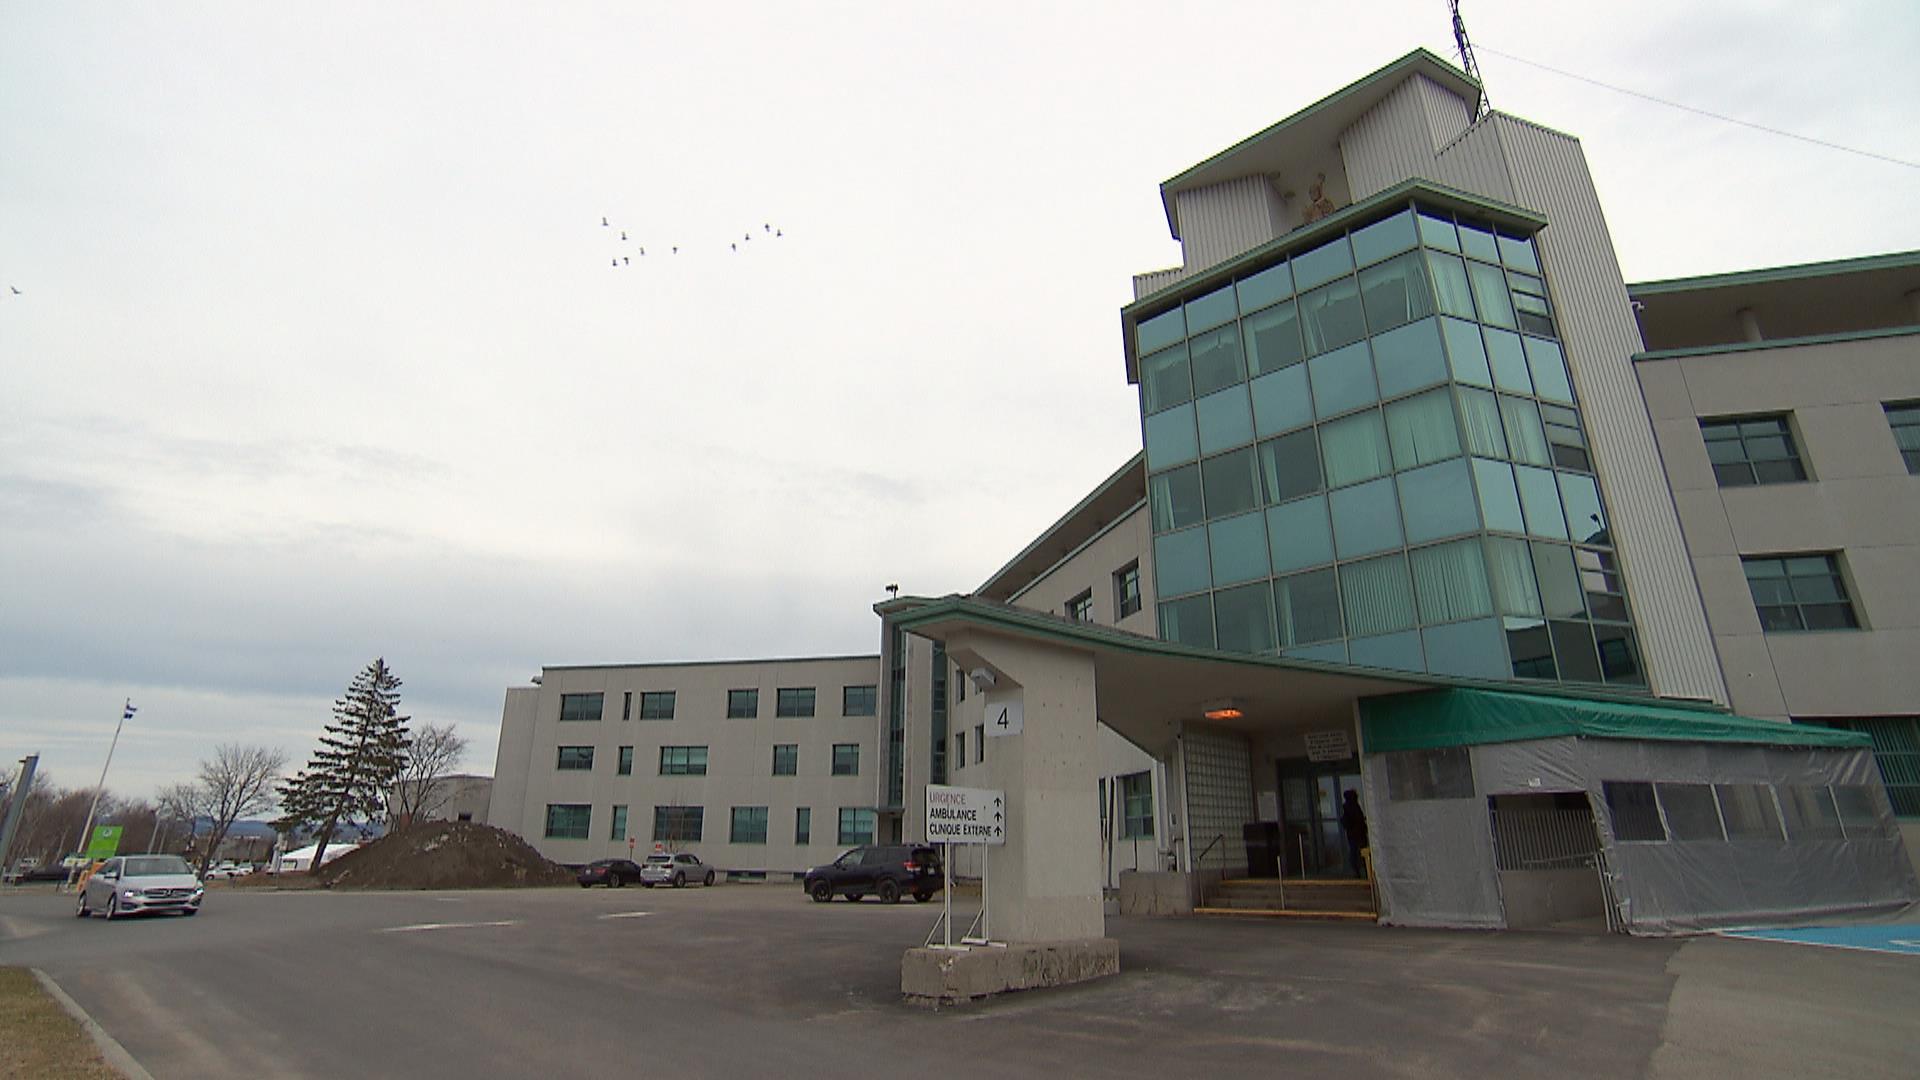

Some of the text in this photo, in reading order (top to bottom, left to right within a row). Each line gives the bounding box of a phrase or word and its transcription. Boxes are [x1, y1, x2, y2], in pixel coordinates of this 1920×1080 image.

[997, 707, 1009, 729] 4
[929, 792, 966, 805] URGENCE
[930, 807, 977, 821] AMBULANCE
[929, 823, 992, 837] CLINIQUE EXTERNE
